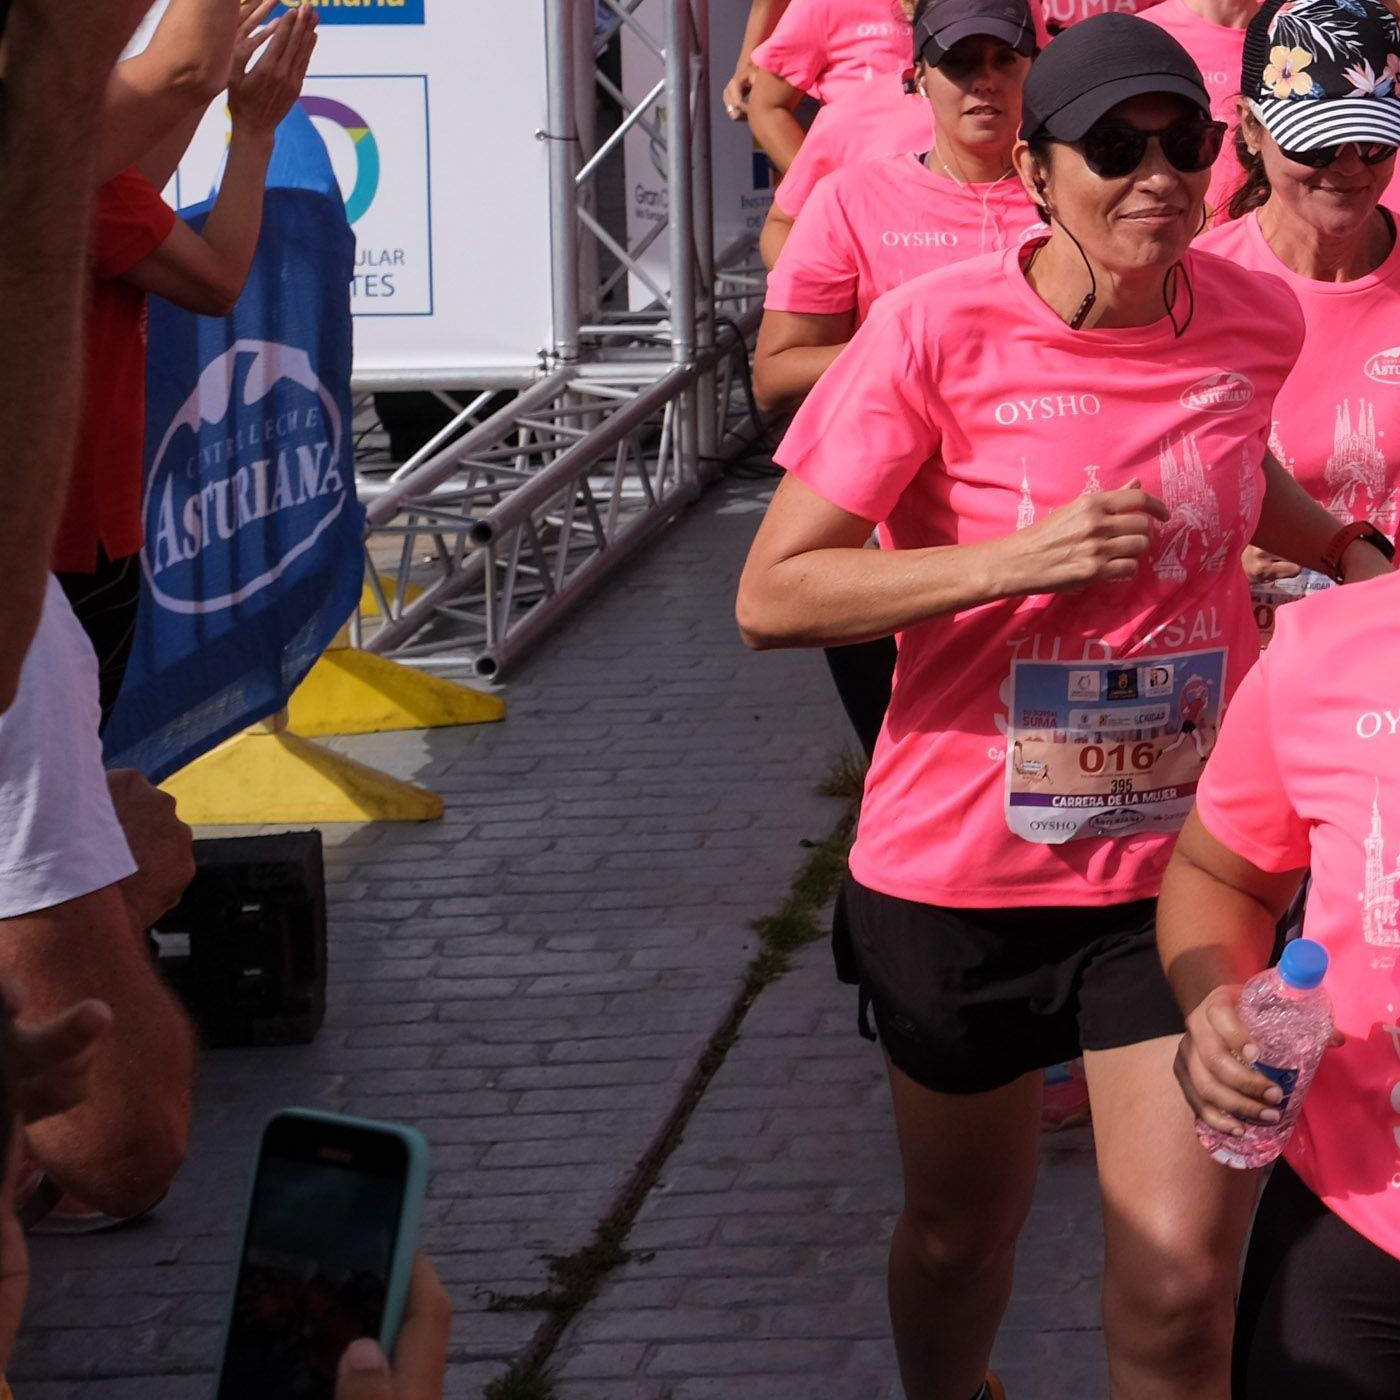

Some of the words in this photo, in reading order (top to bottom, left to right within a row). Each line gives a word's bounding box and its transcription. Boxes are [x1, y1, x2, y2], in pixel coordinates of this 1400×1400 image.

[882, 231, 958, 247] OYSHO
[995, 393, 1101, 425] OYSHO
[153, 442, 344, 576] ASTURIANA
[1021, 716, 1058, 729] SUMA
[1077, 742, 1155, 773] 016
[1110, 779, 1133, 794] 395
[1051, 794, 1106, 809] CARRERA
[1107, 792, 1123, 807] DE
[1125, 791, 1141, 806] LA
[1142, 788, 1178, 805] MUJER
[1029, 819, 1077, 831] OYSHO
